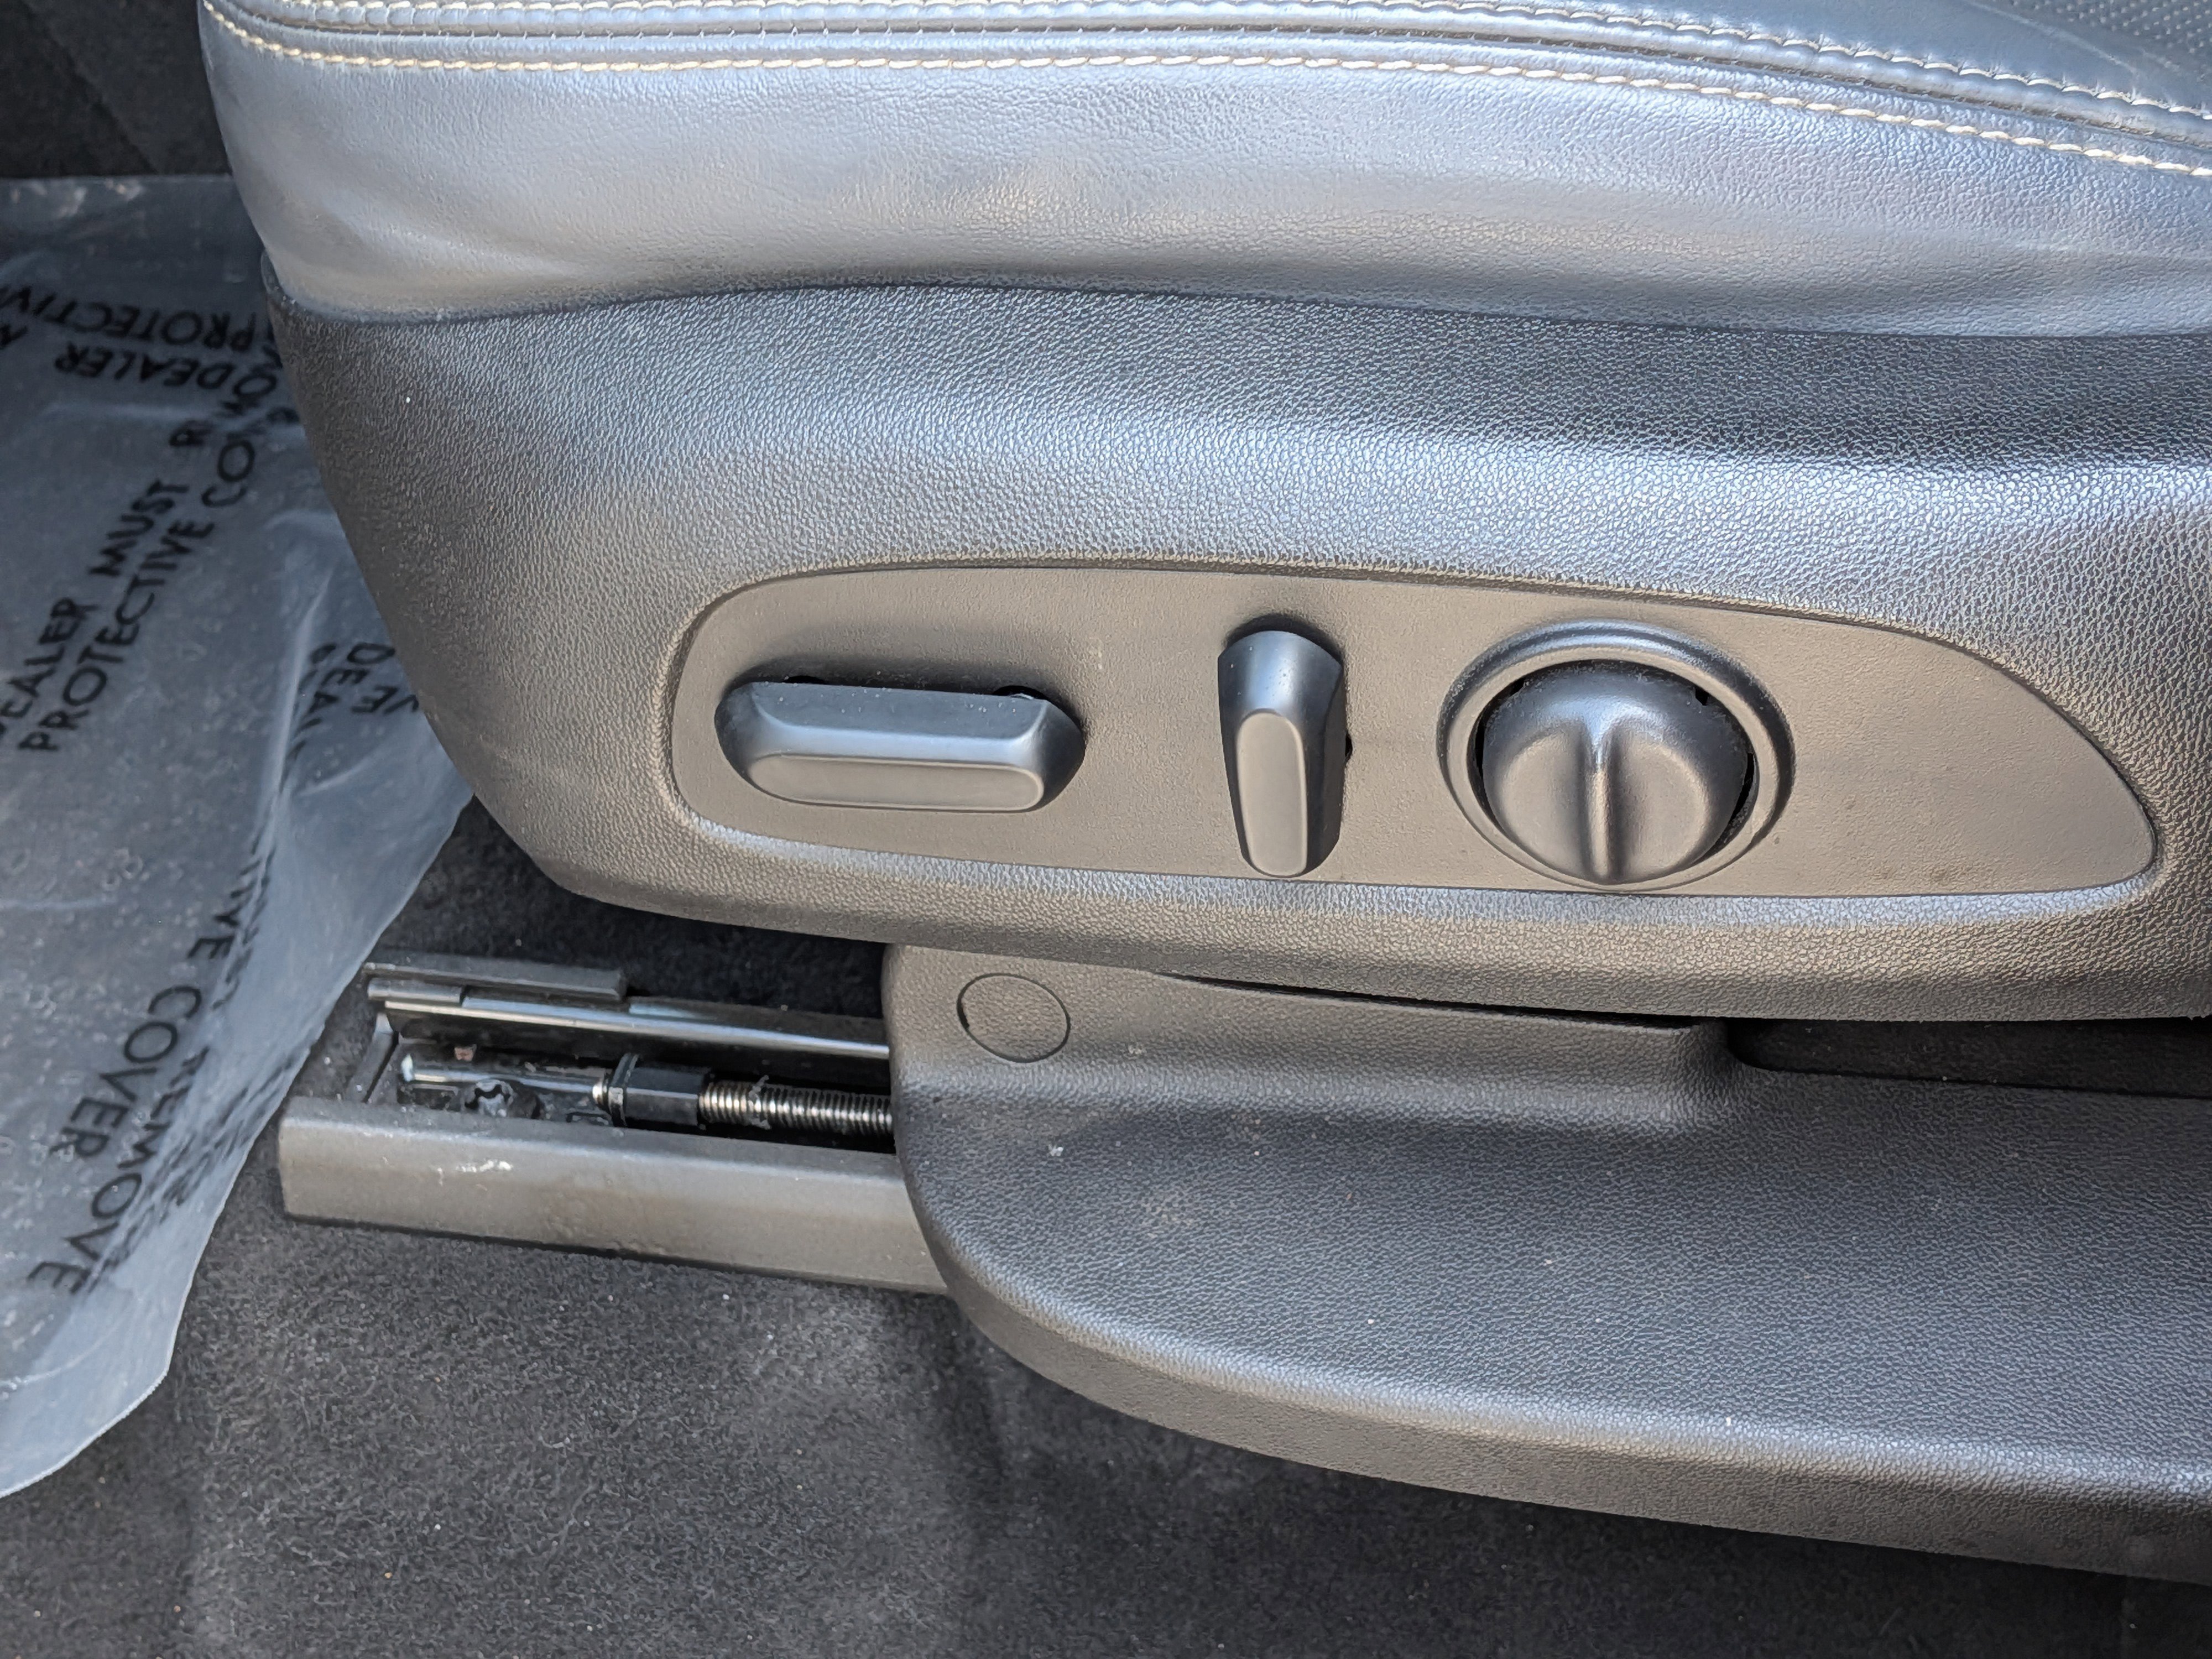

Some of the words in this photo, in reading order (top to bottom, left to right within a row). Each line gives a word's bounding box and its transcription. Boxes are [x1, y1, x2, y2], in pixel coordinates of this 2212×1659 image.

[0, 284, 256, 353] PROTECTIV
[54, 341, 234, 390] DEALER
[88, 478, 189, 576] MUST
[18, 520, 215, 750] PROTECTIVE
[49, 985, 202, 1157] COVER
[27, 1045, 210, 1295] REMOVE
